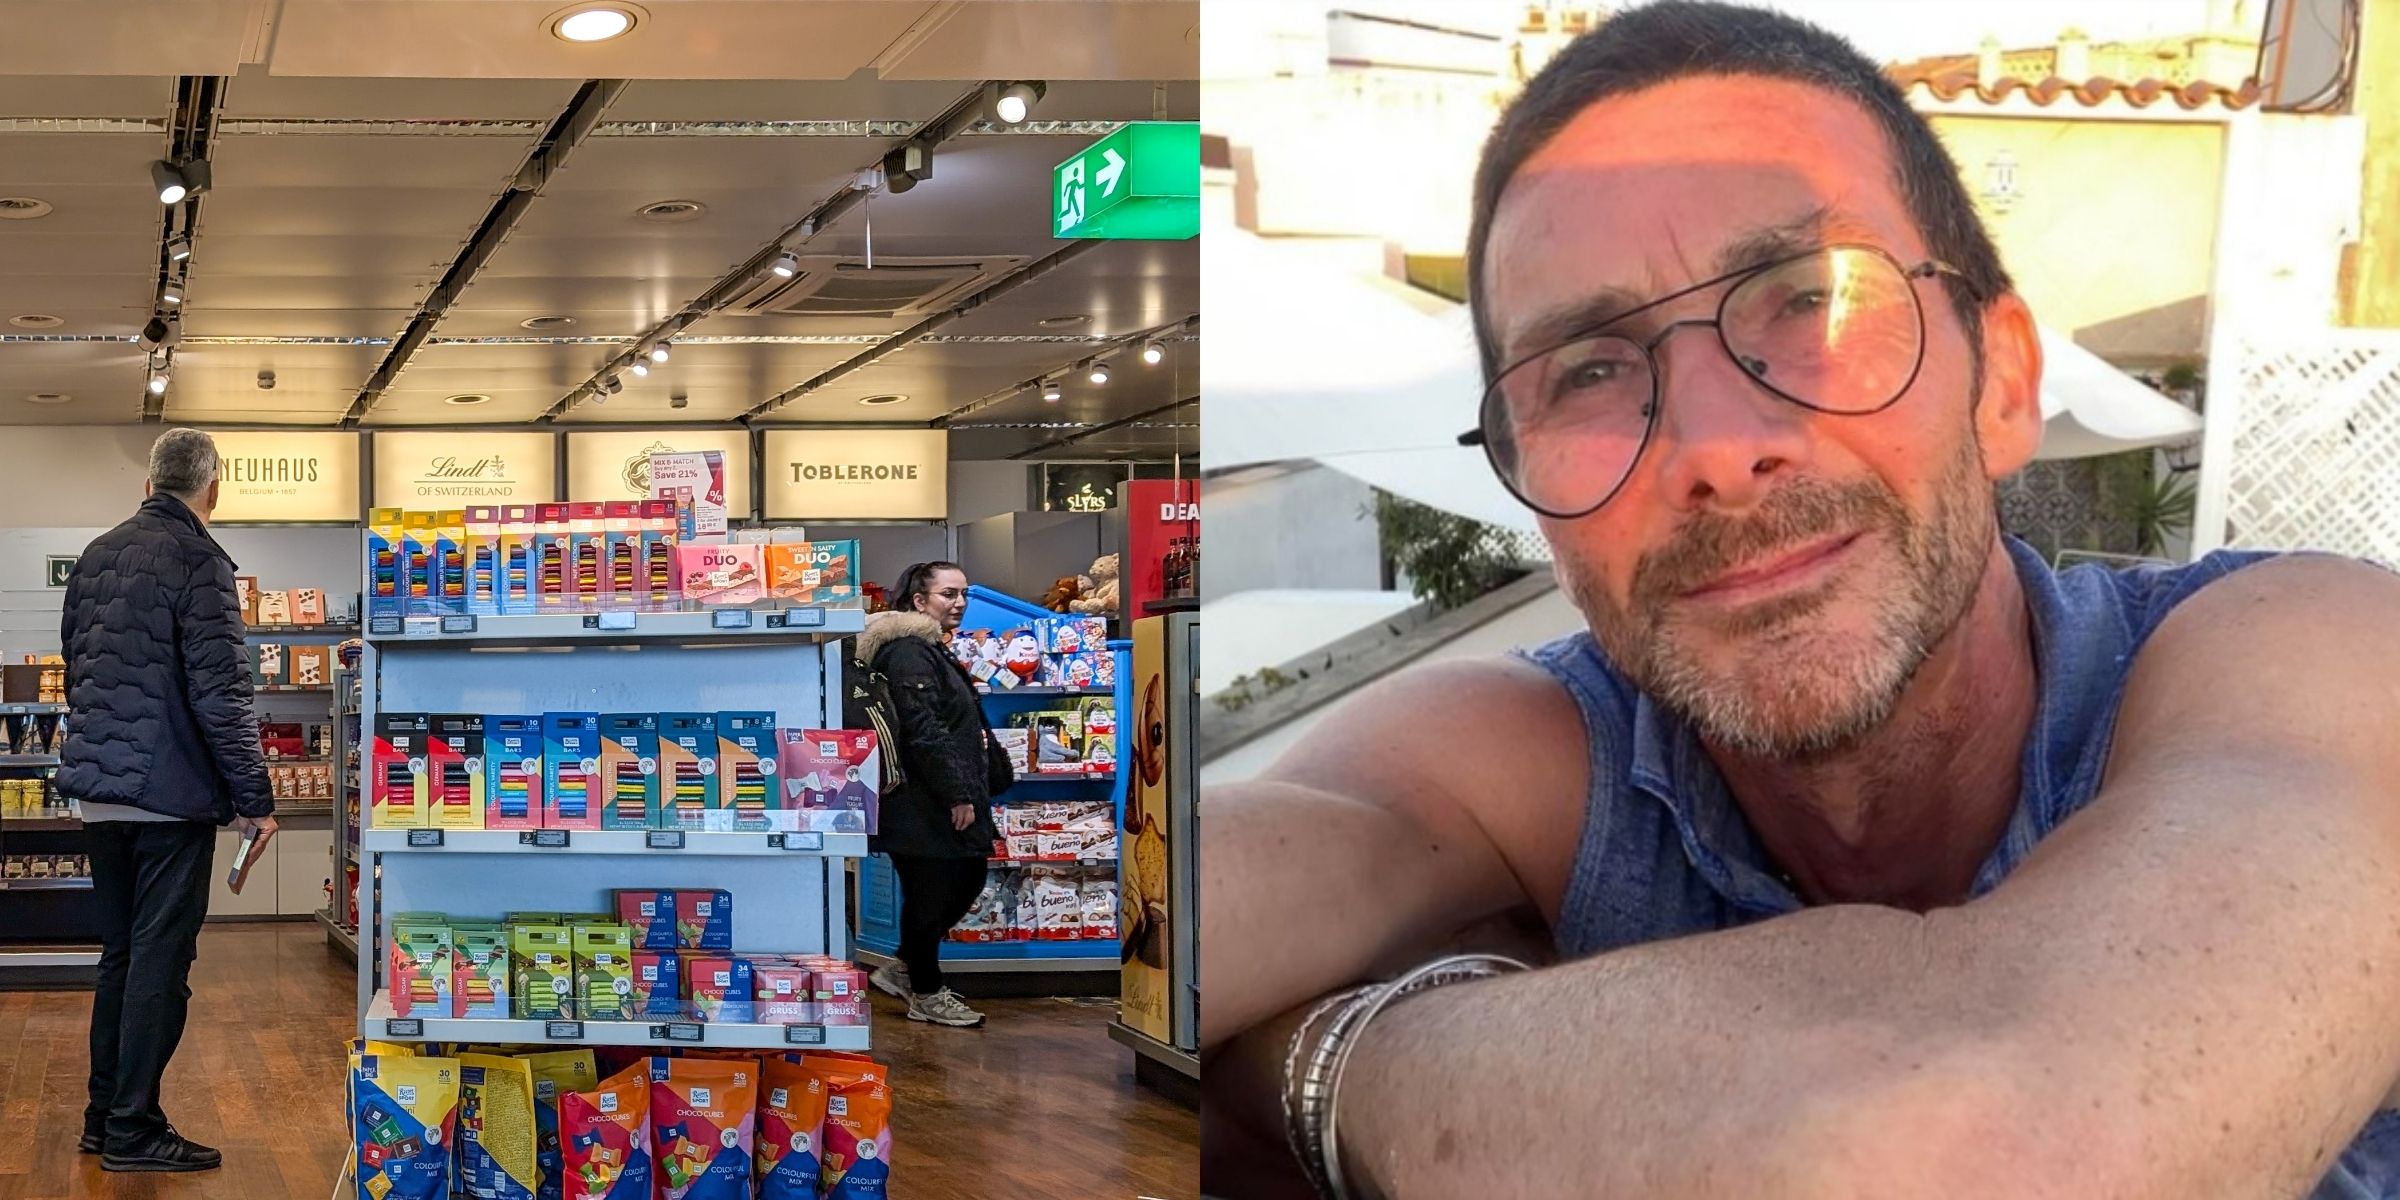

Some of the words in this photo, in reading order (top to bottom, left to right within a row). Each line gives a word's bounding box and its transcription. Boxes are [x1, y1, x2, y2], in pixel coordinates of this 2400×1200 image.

[219, 458, 318, 482] NEUHAUS
[424, 456, 489, 478] Lindt
[790, 462, 918, 483] TOBLERONE
[654, 471, 677, 479] Save
[678, 470, 698, 478] 21%
[417, 487, 433, 496] OF
[434, 486, 513, 497] SWITZERLAND
[710, 490, 722, 501] %
[1067, 491, 1106, 512] SLYRS
[1160, 503, 1200, 521] DEA
[817, 544, 836, 552] SALTY
[703, 555, 738, 566] DUO
[794, 551, 831, 565] DUO
[1051, 840, 1080, 851] bueno
[1041, 895, 1073, 908] bueno
[827, 1007, 856, 1015] GRUSS
[439, 1069, 450, 1077] 30
[735, 1072, 746, 1080] 50
[588, 1115, 611, 1123] CHOCO
[677, 1109, 703, 1117] CHOCO
[703, 1110, 725, 1118] CUBES
[779, 1111, 798, 1121] CUBES
[840, 1119, 862, 1128] CUBES
